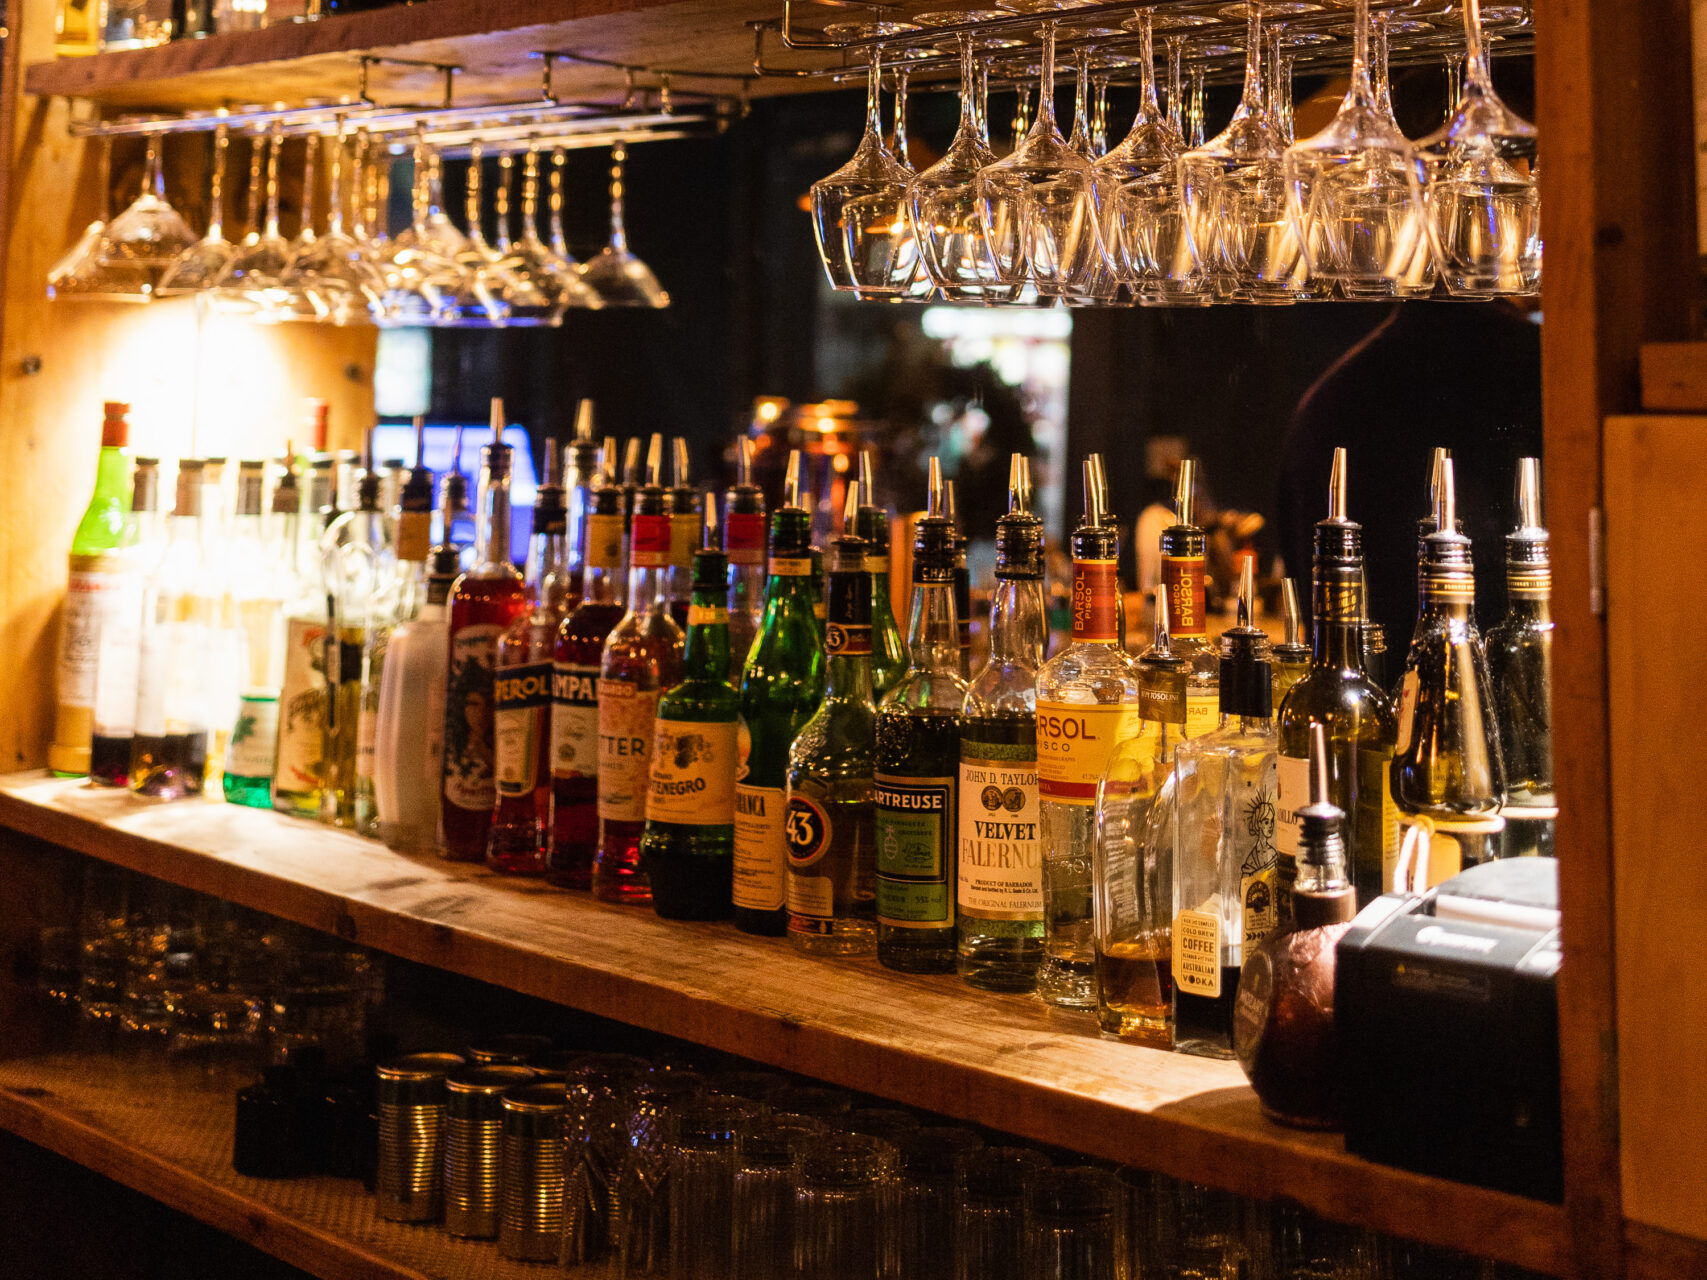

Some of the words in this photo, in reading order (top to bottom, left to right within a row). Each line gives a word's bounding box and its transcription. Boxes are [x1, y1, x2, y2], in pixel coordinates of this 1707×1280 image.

[1074, 570, 1086, 632] BARSOL
[1084, 587, 1093, 619] PISCO
[552, 673, 600, 700] MPA
[965, 769, 987, 784] JOHN
[990, 772, 998, 785] D.
[786, 810, 814, 846] 43
[974, 820, 1037, 841] VELVET
[961, 837, 1043, 870] FALERNU
[975, 879, 997, 888] PRODUCT
[1005, 881, 1033, 889] BARBADOS
[1182, 926, 1197, 935] COLD
[1197, 928, 1215, 938] BREW
[1182, 937, 1215, 953] COFFEE
[1182, 961, 1215, 975] AUSTRALIAN
